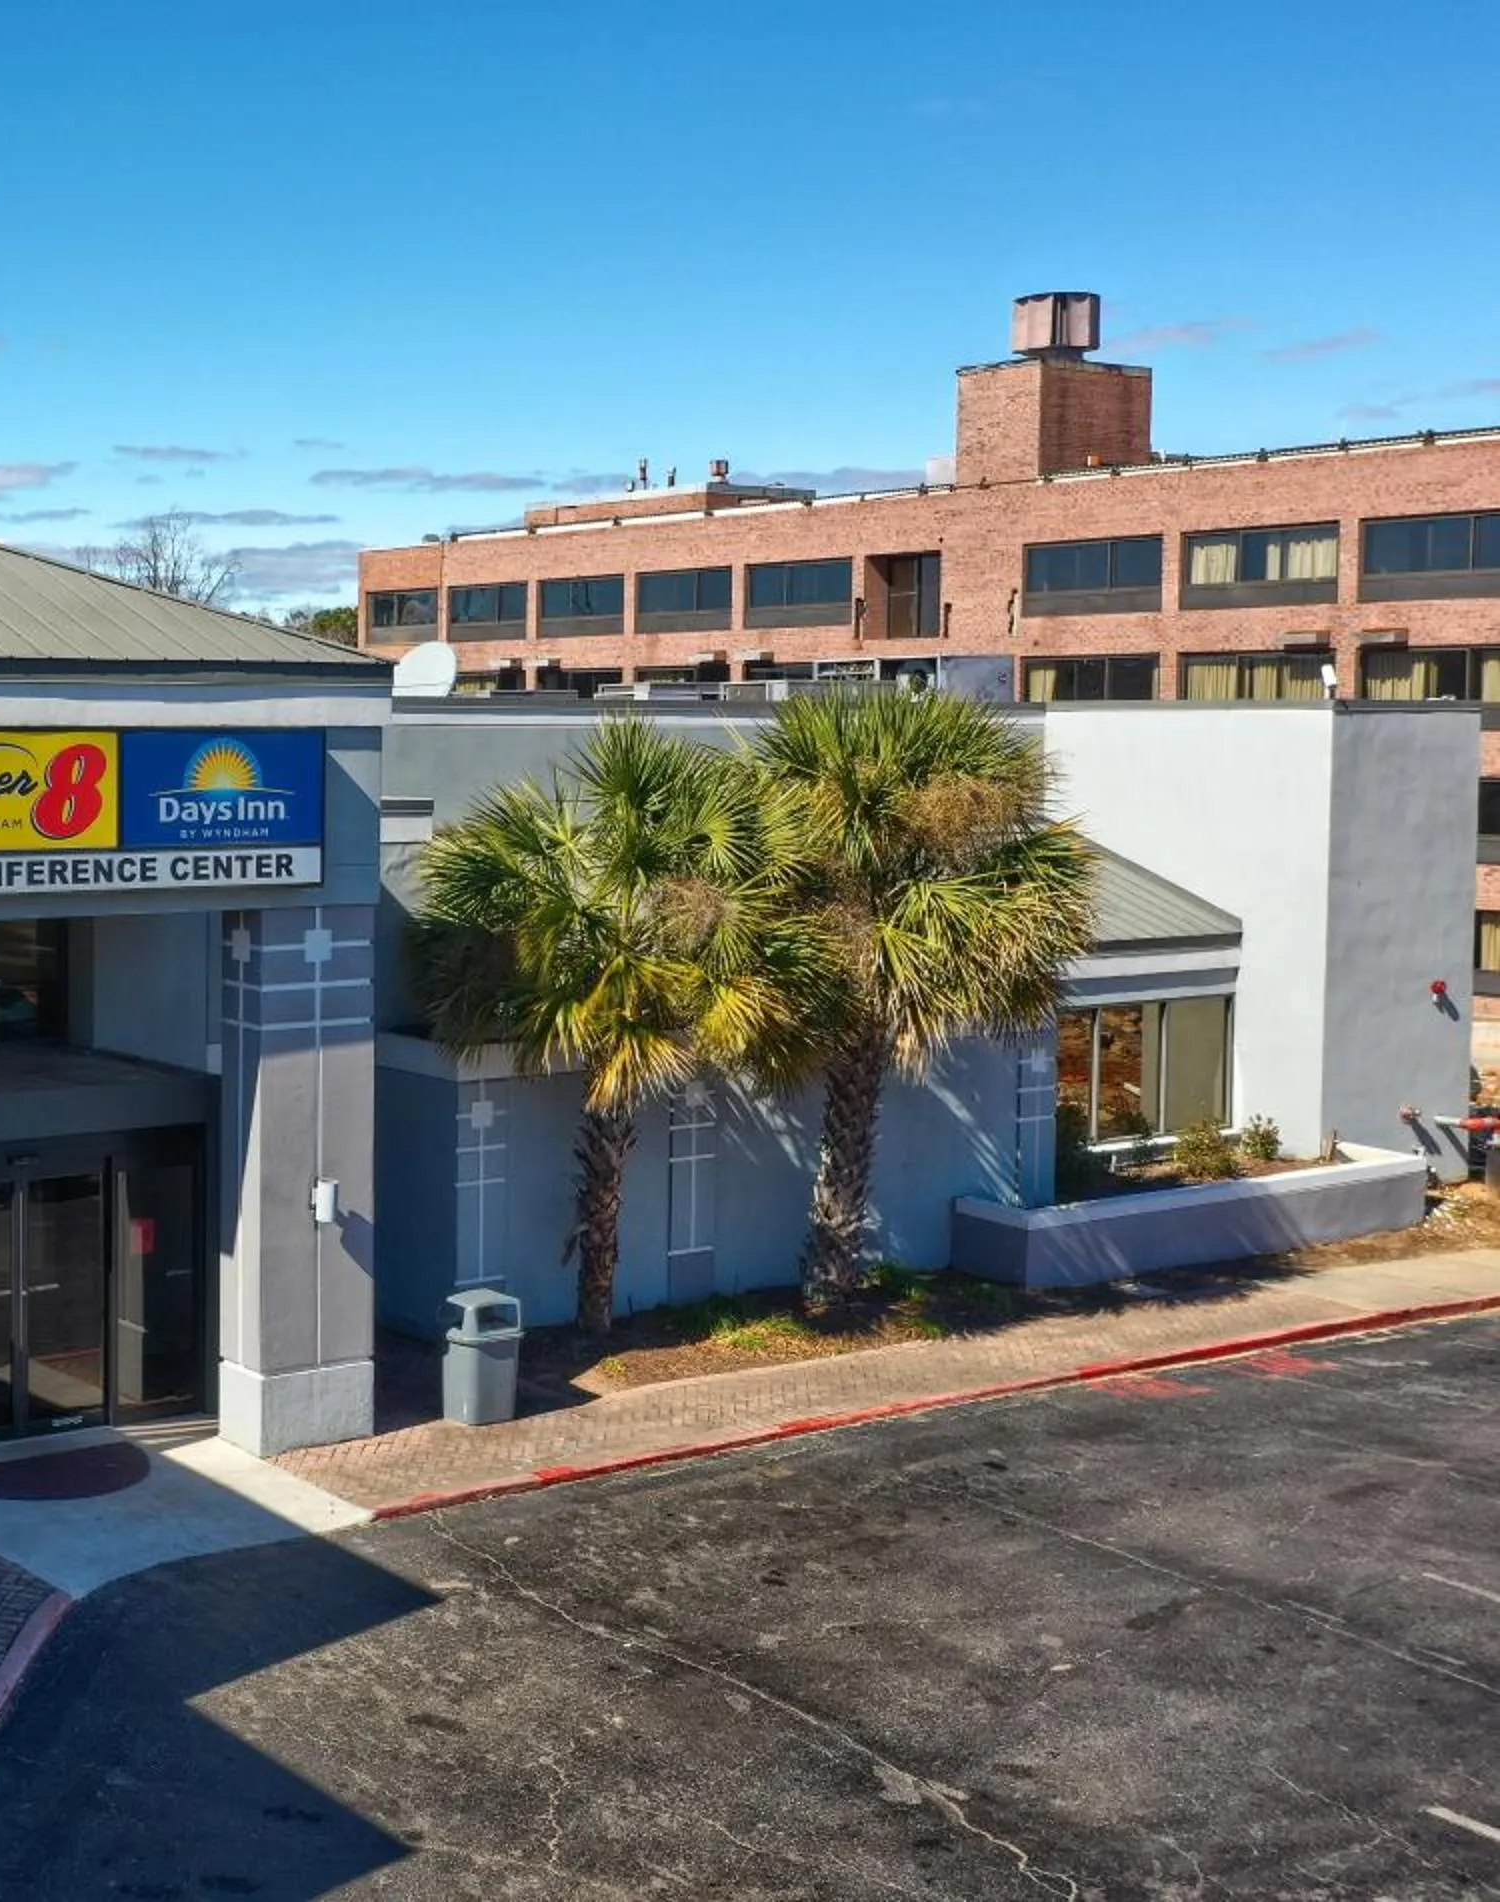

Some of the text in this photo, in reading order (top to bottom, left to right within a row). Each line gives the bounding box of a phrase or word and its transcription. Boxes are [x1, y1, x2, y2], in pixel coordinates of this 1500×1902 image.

[30, 743, 107, 840] 8
[159, 797, 286, 825] Days Inn
[179, 827, 269, 839] BY WYNDHAM
[170, 854, 295, 881] CENTER
